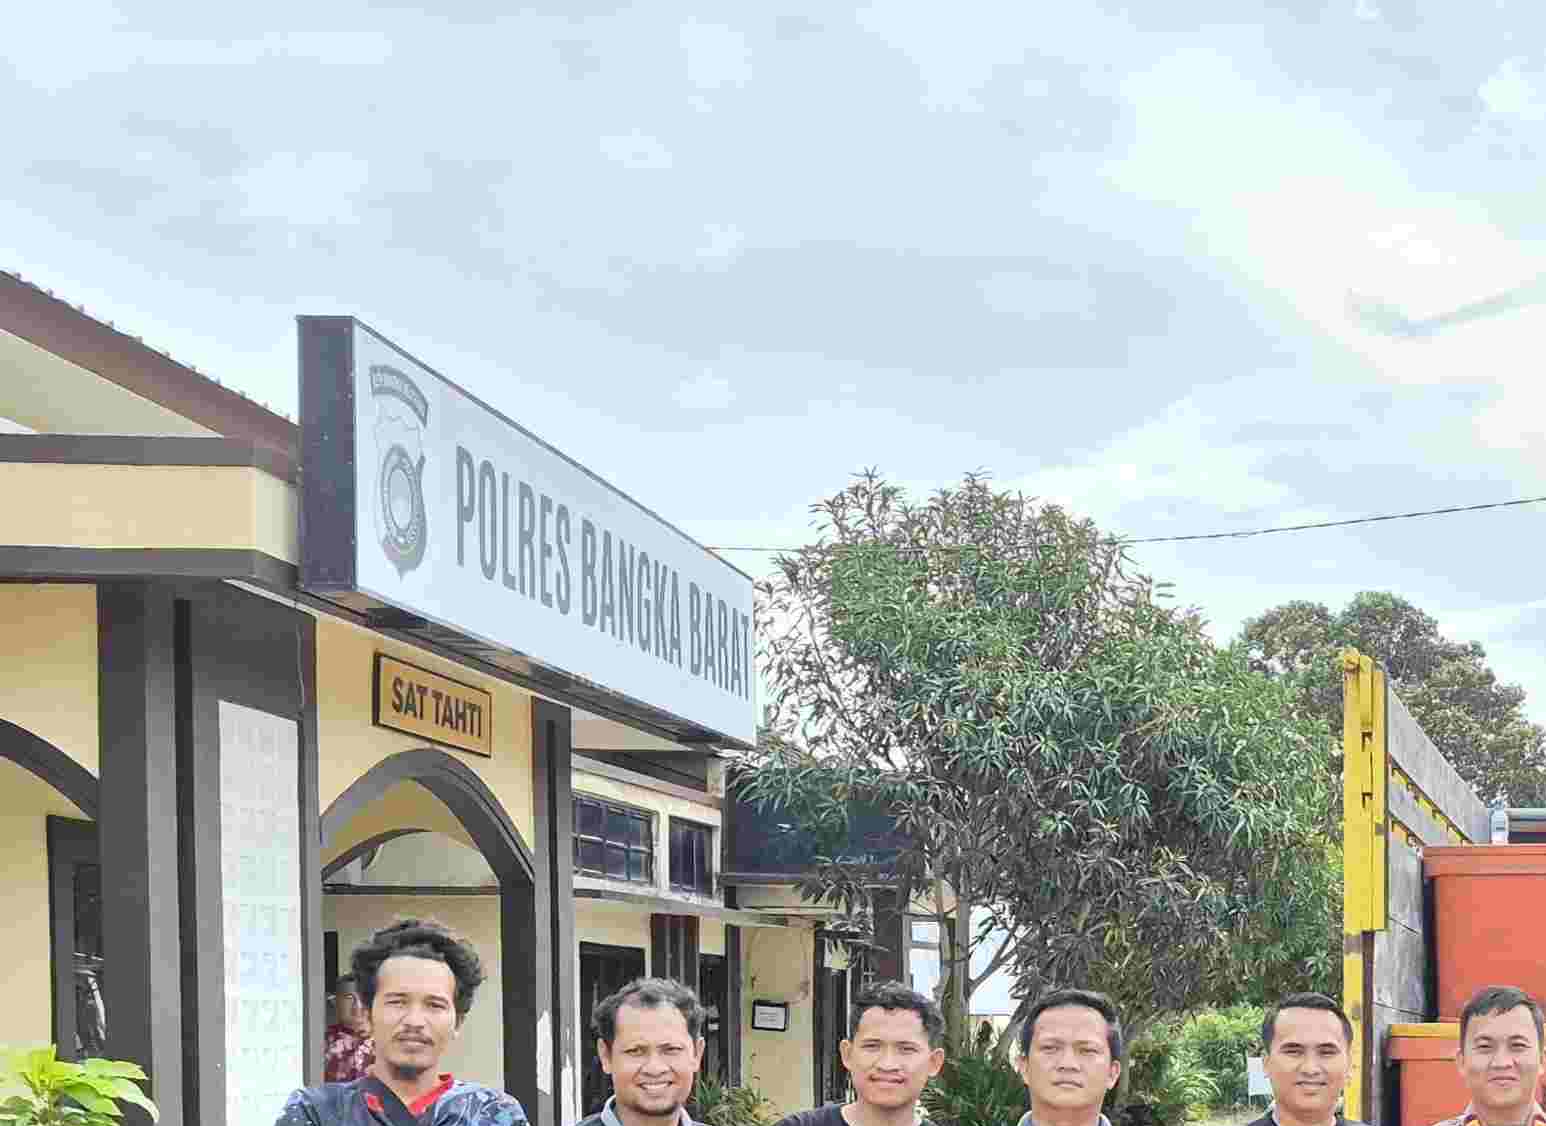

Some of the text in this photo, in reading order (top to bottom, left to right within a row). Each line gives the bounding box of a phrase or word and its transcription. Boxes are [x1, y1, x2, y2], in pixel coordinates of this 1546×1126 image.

[456, 445, 570, 615] POLRES
[582, 519, 682, 670] BANGKA
[689, 581, 749, 701] BARAT
[392, 676, 481, 737] SAT TAHTI
